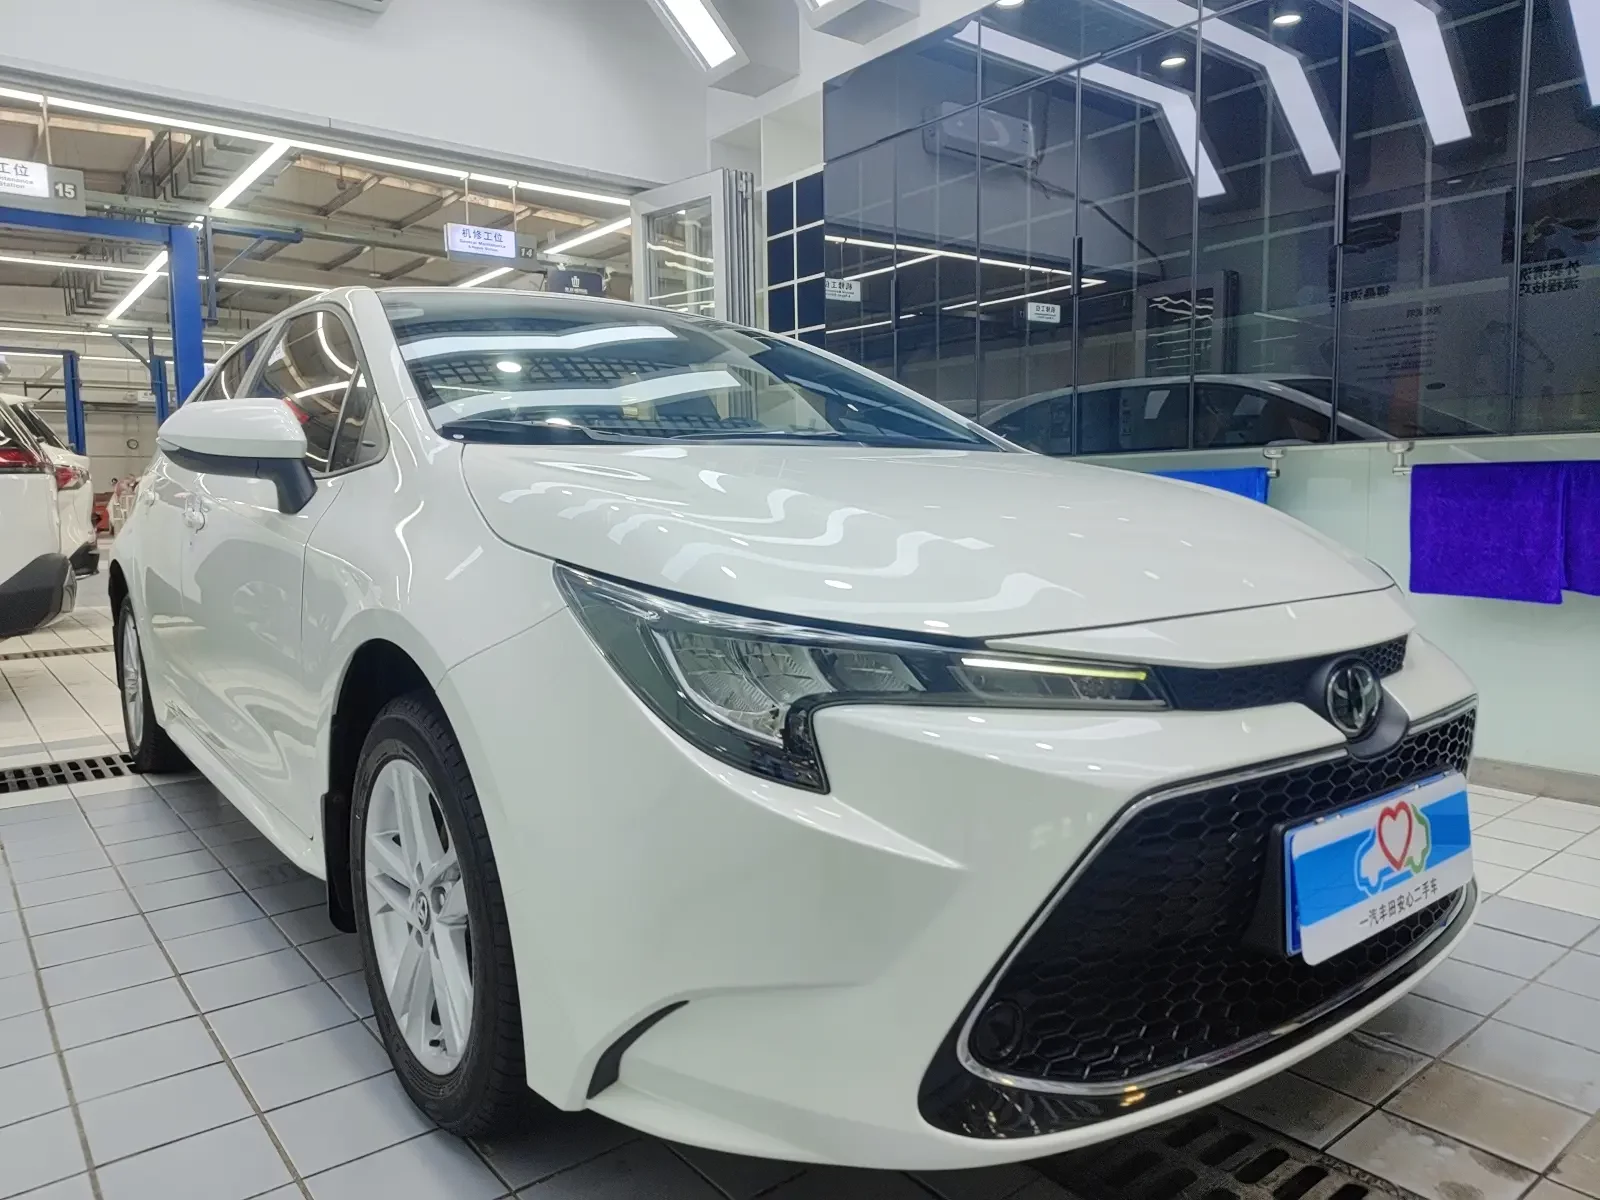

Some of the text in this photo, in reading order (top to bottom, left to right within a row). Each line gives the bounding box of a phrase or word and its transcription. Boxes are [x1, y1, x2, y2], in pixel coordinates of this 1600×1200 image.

[55, 183, 75, 198] 15
[461, 227, 503, 242] 机修工位
[521, 248, 533, 258] 14
